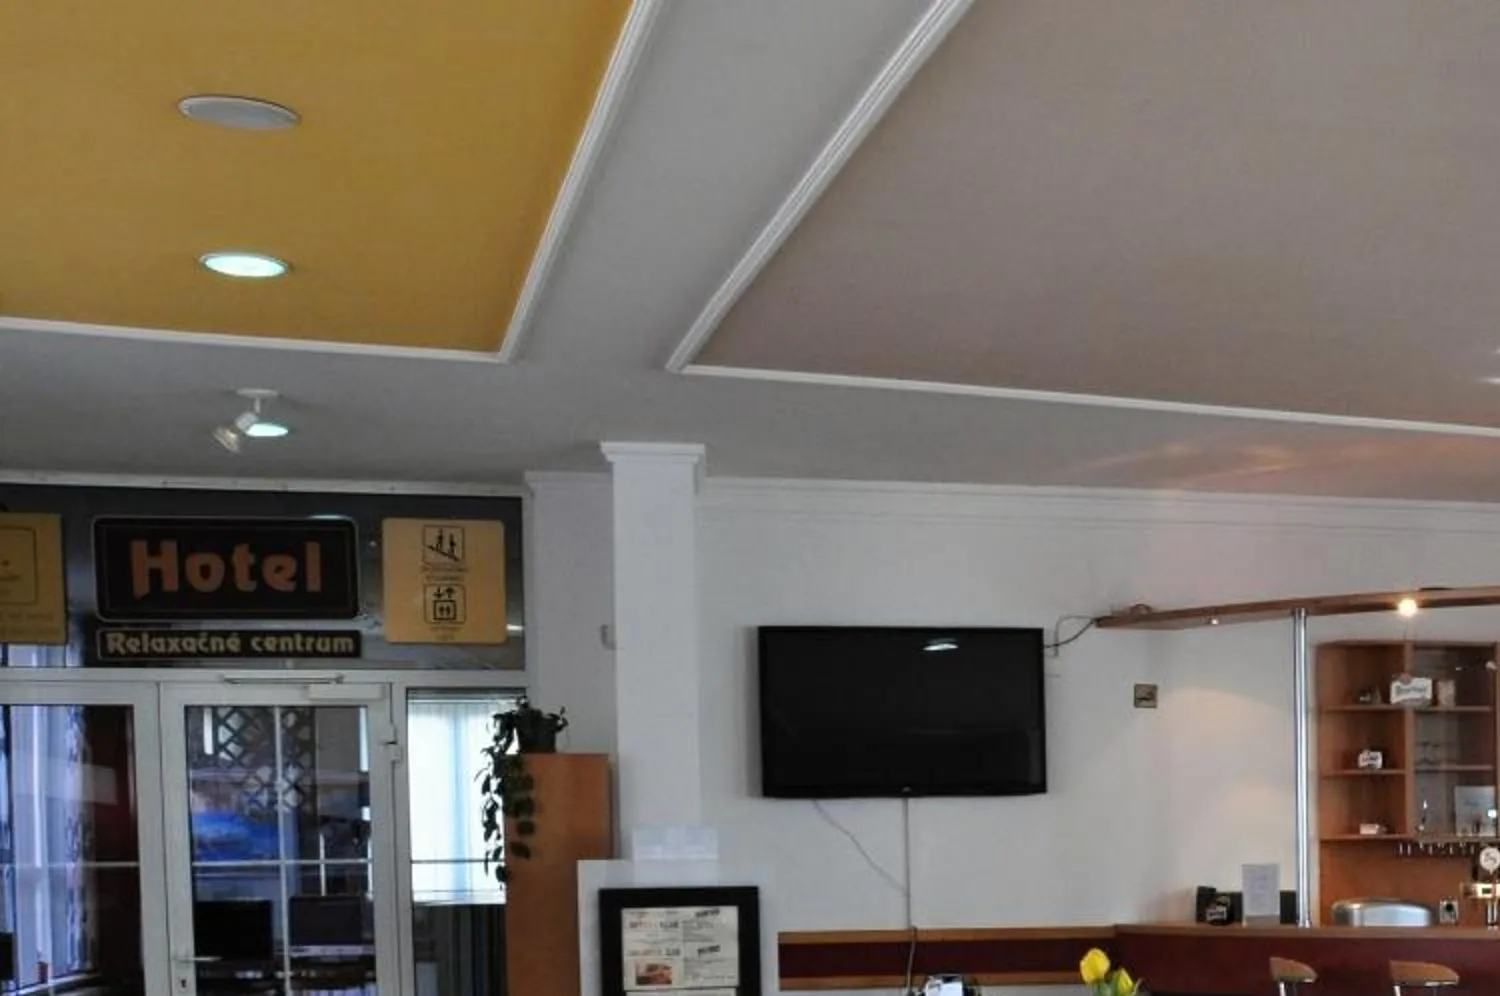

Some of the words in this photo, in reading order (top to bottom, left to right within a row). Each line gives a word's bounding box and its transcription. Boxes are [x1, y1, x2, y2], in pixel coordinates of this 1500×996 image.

[130, 540, 322, 599] Hotel
[106, 632, 241, 655] Relaxačné
[252, 633, 353, 653] centrum
